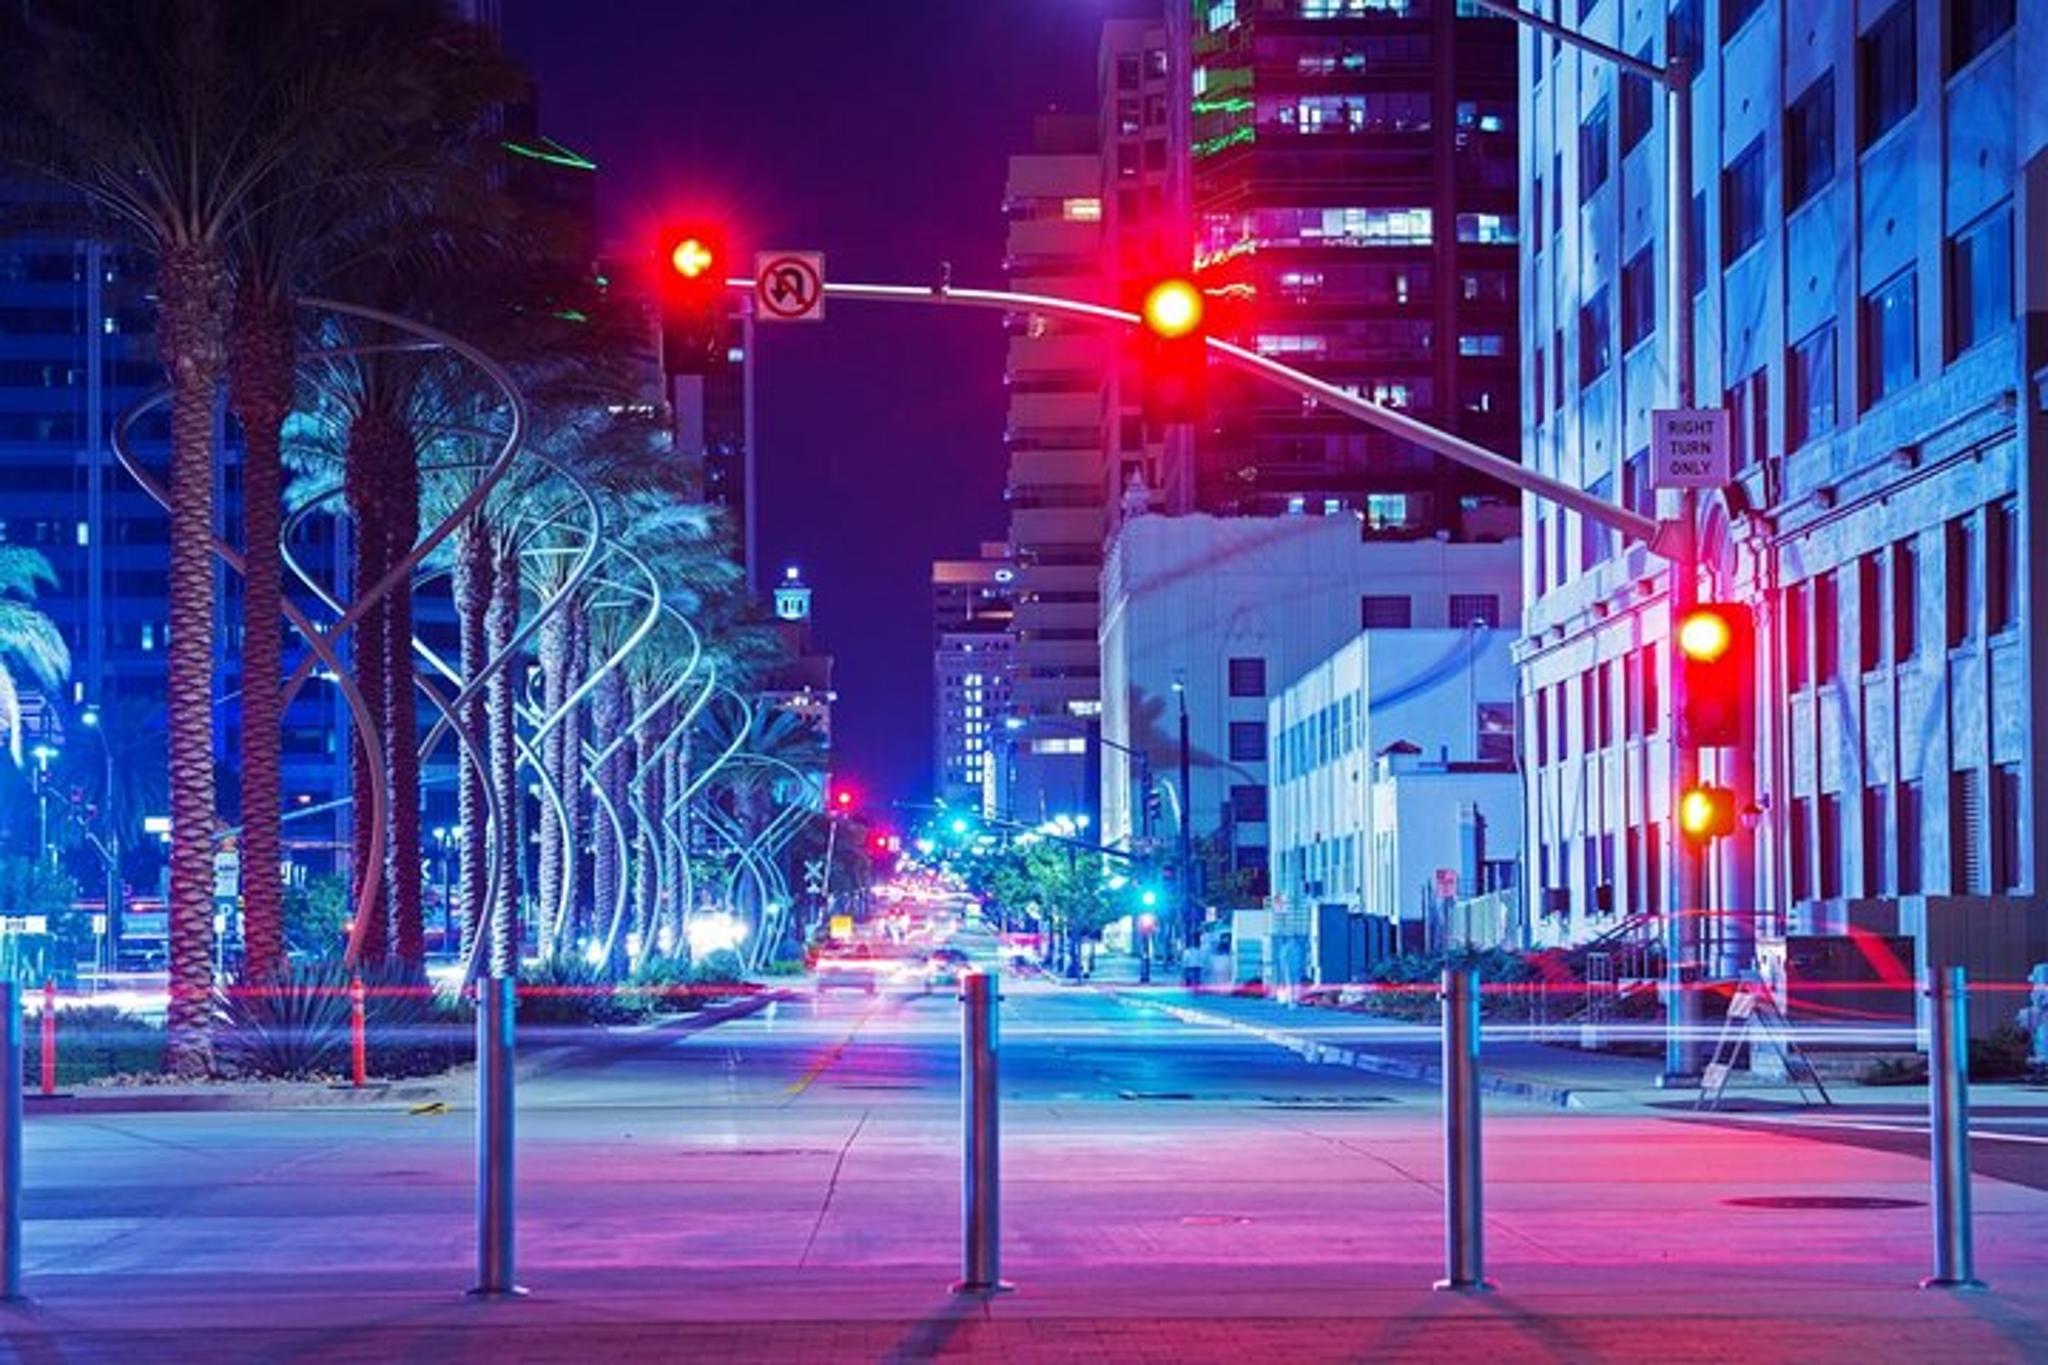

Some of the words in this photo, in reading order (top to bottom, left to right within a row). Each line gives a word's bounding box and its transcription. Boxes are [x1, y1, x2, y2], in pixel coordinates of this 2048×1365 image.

[1668, 420, 1713, 435] RIGHT
[1670, 441, 1711, 455] TURN
[1670, 460, 1711, 475] ONLY
